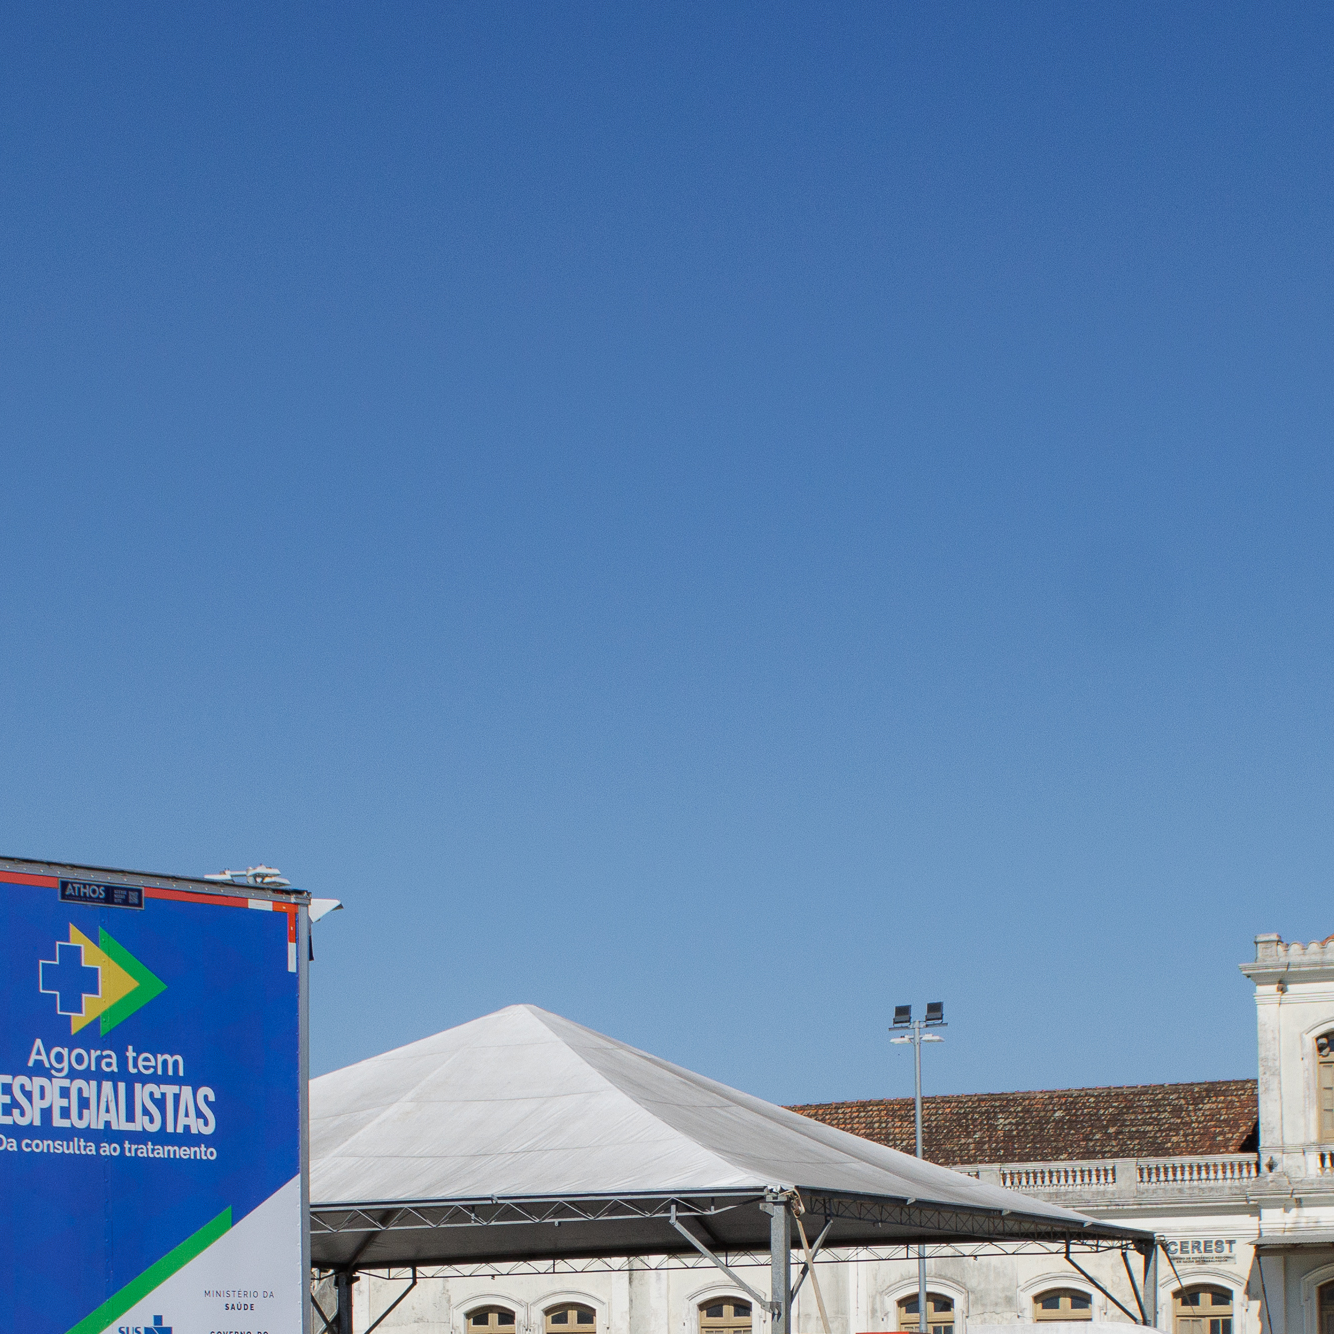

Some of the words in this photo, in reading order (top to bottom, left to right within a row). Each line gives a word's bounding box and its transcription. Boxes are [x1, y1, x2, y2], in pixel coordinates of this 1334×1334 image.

[65, 883, 106, 899] ATHOS
[27, 1038, 118, 1077] Agora
[126, 1045, 184, 1076] tem
[21, 1137, 96, 1155] consulta
[100, 1142, 120, 1156] ao
[123, 1140, 217, 1160] tratamento
[1167, 1240, 1237, 1254] CEREST
[204, 1289, 259, 1298] MINISTÉRIO
[262, 1290, 275, 1298] DA
[224, 1302, 255, 1311] SAÚDE
